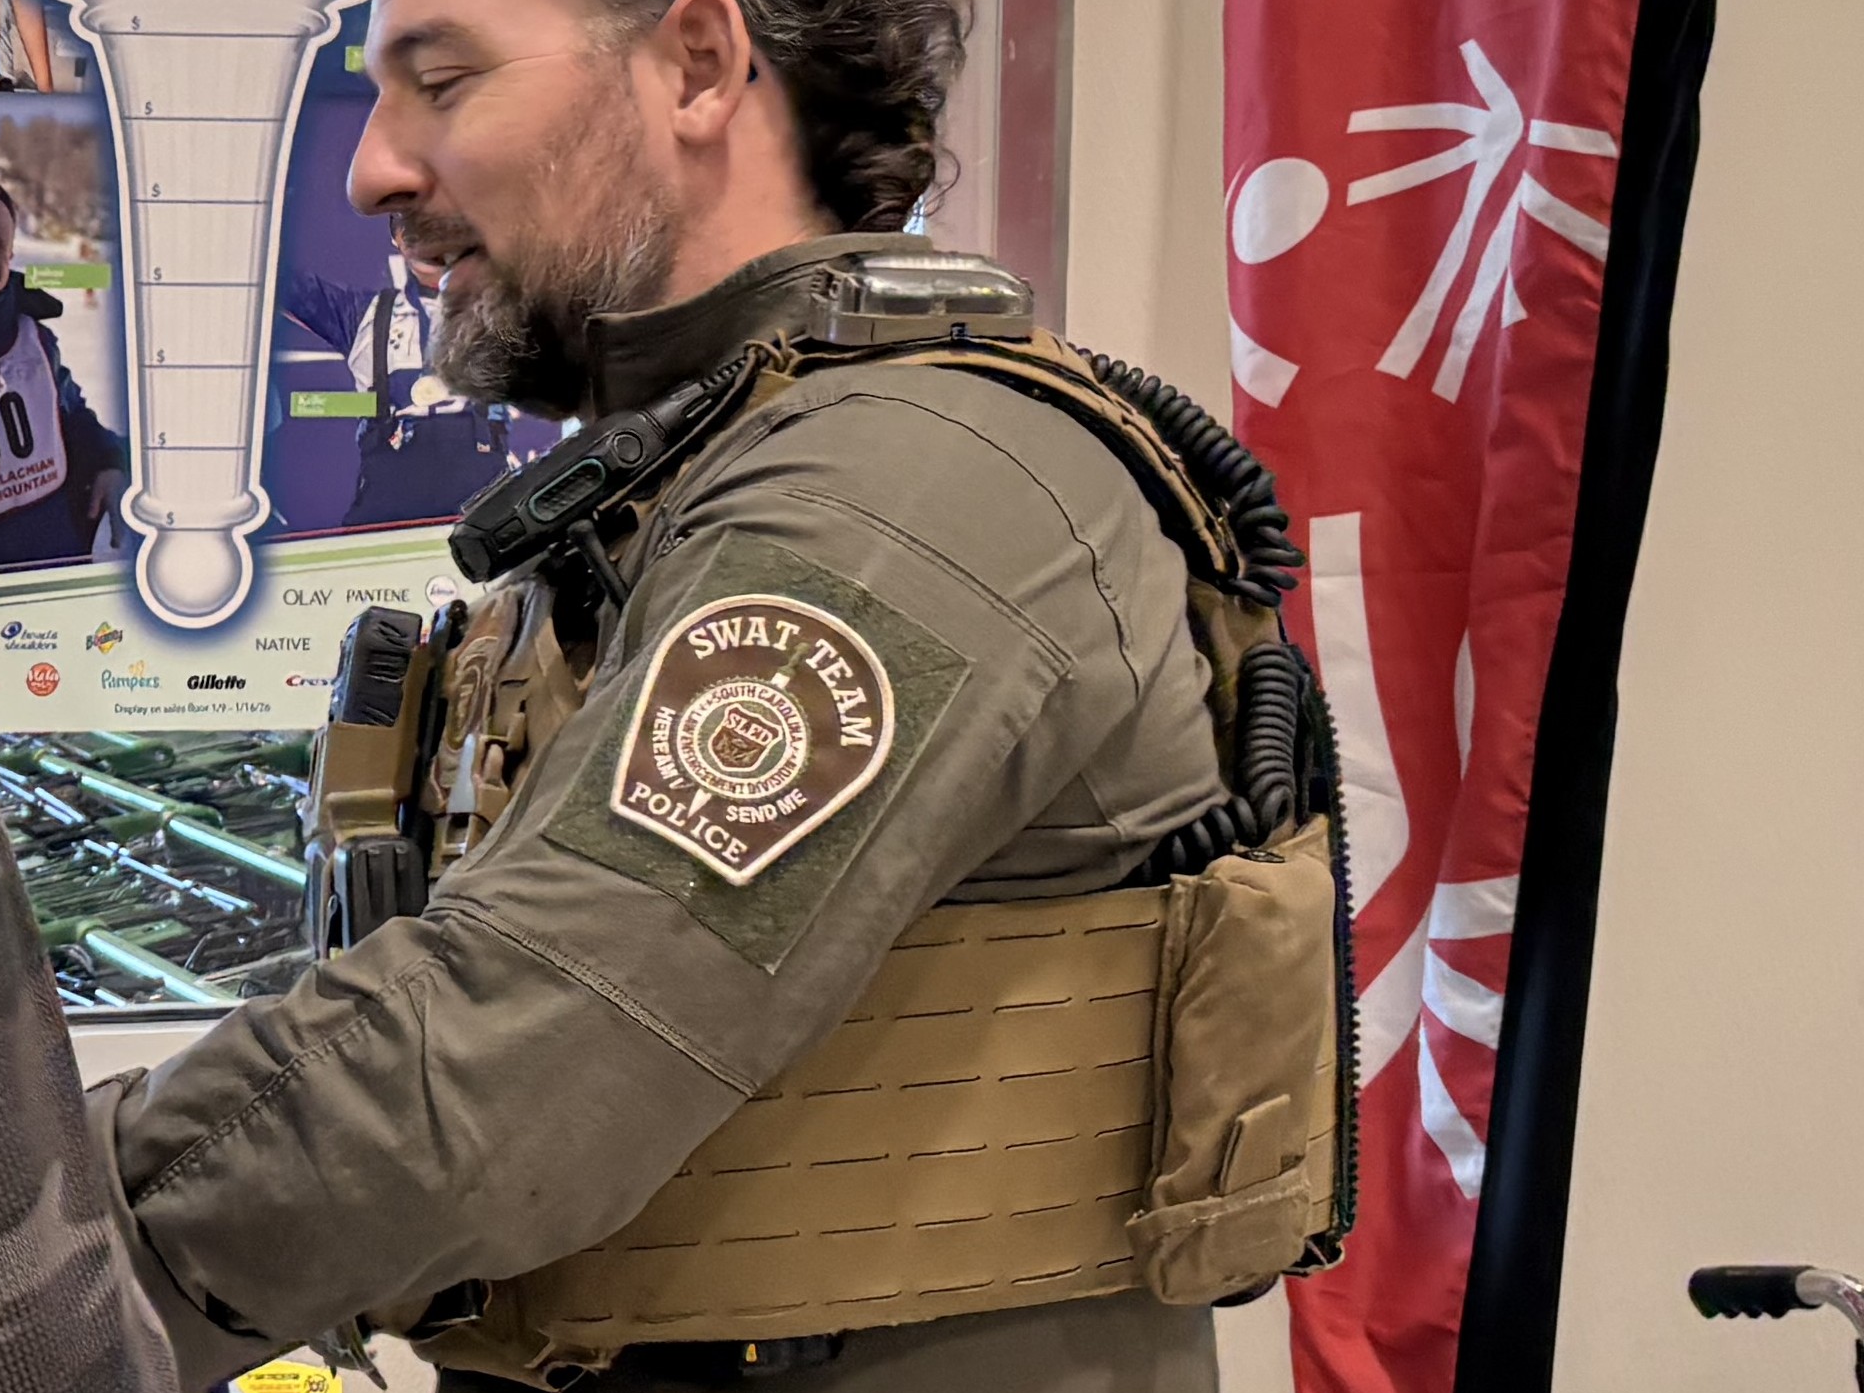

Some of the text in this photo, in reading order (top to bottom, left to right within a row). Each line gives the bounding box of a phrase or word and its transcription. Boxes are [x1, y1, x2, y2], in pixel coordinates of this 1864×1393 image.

[283, 588, 333, 606] OLAY
[346, 588, 410, 603] PANTENE
[255, 637, 311, 651] NATIVE
[101, 669, 160, 693] Pampers
[187, 674, 246, 690] Gillette
[687, 616, 873, 748] SWAT TEAM
[712, 685, 756, 703] SOUTH
[114, 703, 147, 715] Display
[150, 706, 161, 714] on
[652, 706, 676, 754] HERE
[726, 713, 773, 746] SLED
[726, 788, 807, 824] SEND ME
[628, 782, 748, 863] POLICE
